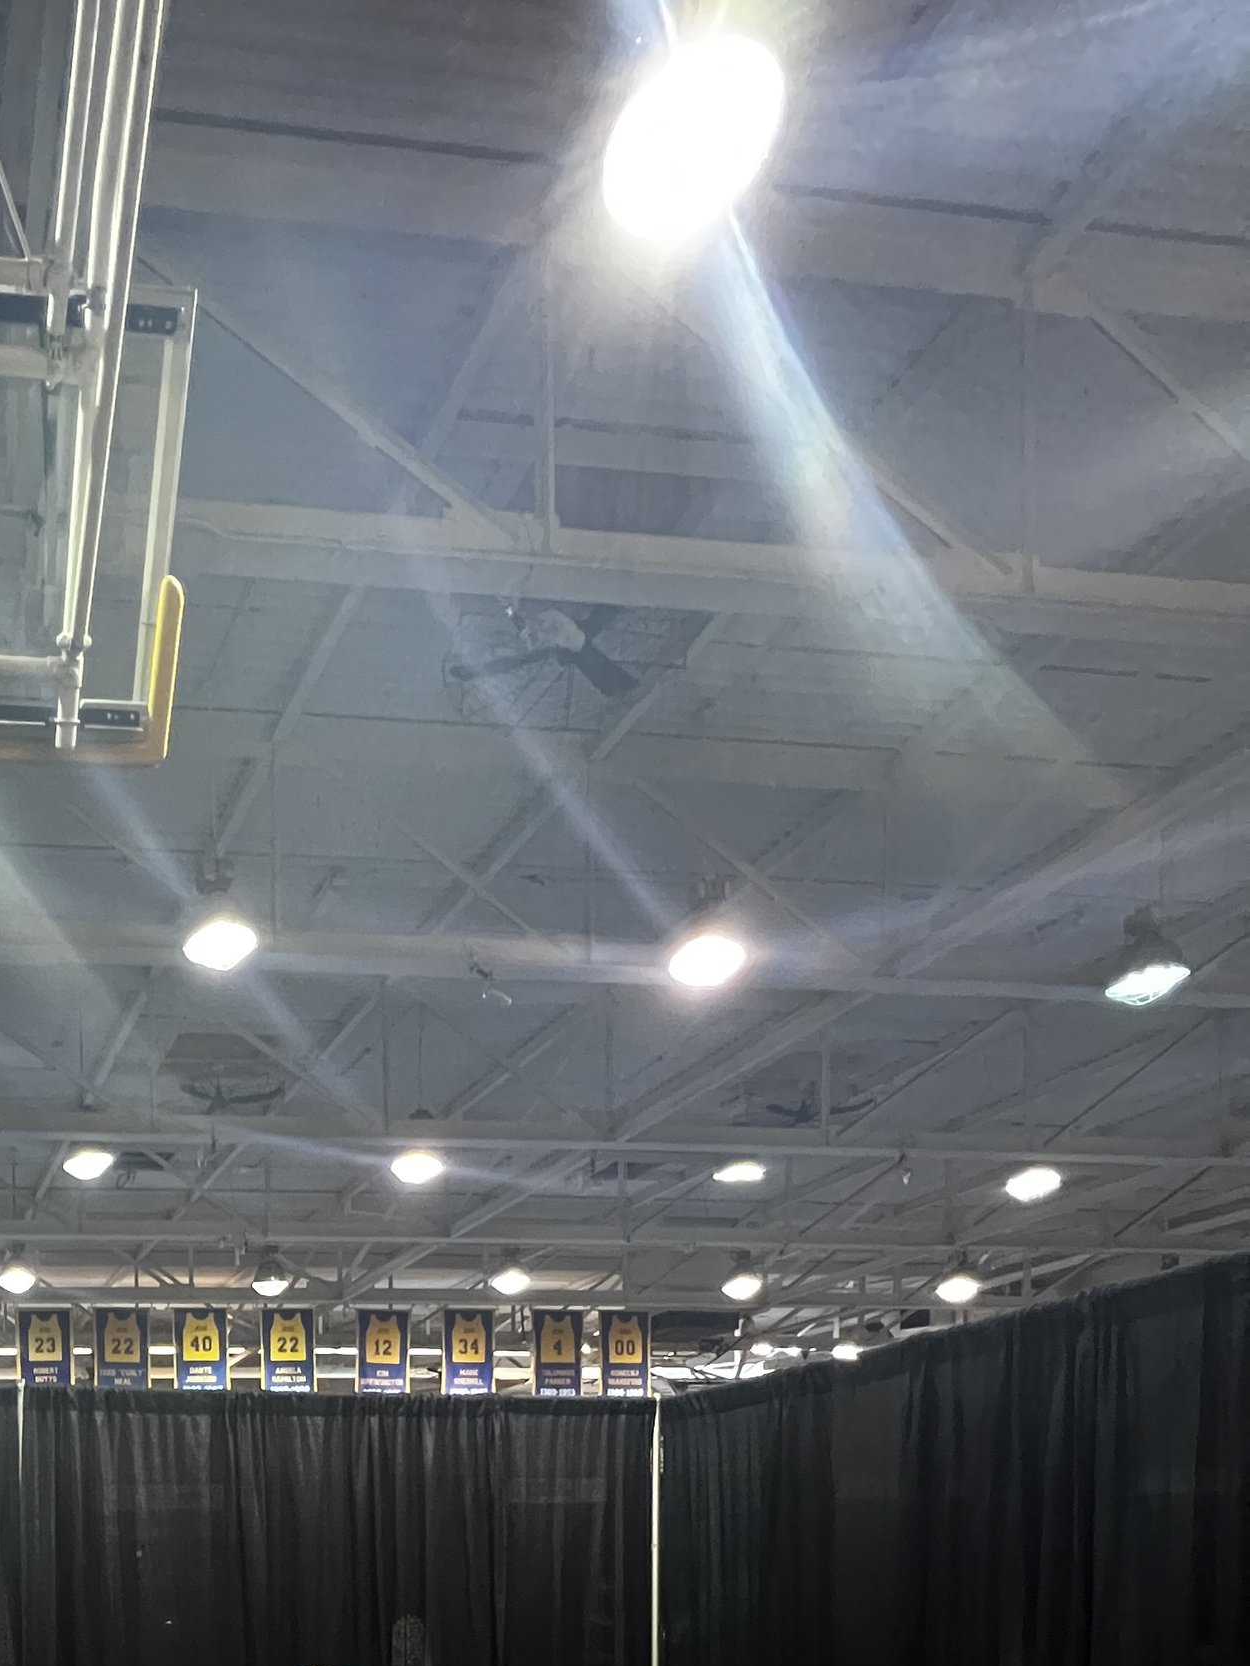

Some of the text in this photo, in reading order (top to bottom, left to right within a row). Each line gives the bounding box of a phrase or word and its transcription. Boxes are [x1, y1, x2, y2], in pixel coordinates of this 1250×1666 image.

[34, 1337, 56, 1353] 23
[111, 1338, 134, 1355] 22
[190, 1335, 212, 1352] 40
[277, 1337, 299, 1353] 22
[374, 1339, 392, 1356] 12
[458, 1338, 479, 1355] 34
[552, 1339, 562, 1356] 4
[615, 1340, 636, 1356] 00
